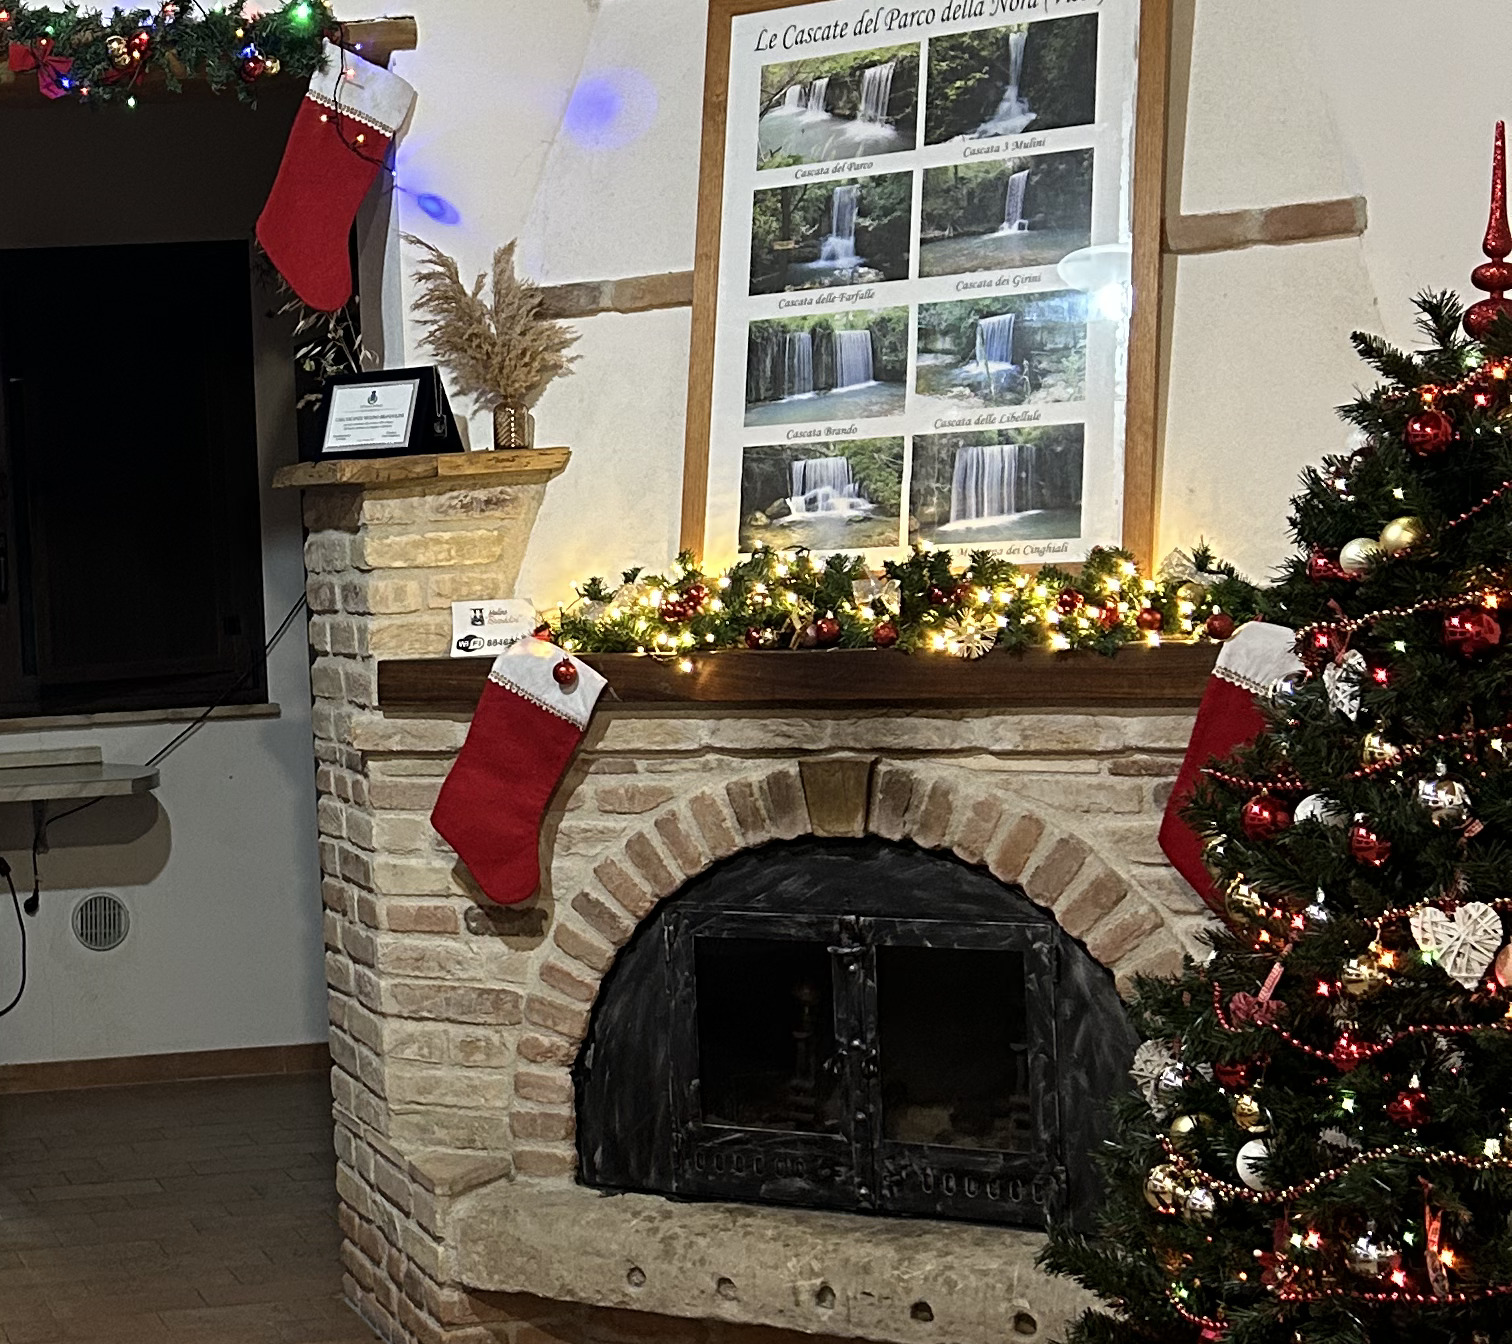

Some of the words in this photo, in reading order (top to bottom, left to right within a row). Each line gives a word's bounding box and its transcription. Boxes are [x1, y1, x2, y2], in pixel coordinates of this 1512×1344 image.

[754, 28, 777, 51] Le
[782, 19, 849, 50] Cascate
[853, 7, 884, 36] del
[885, 7, 936, 32] Parco
[963, 145, 1001, 158] Cascata
[1011, 137, 1046, 152] Mulini
[794, 167, 830, 179] Cascata
[831, 162, 847, 174] del
[847, 161, 874, 172] Parco
[955, 279, 993, 292] Cascata
[995, 274, 1010, 287] dei
[1012, 272, 1042, 288] Girini
[778, 297, 814, 310] Cascata
[815, 292, 836, 305] delle
[836, 288, 876, 304] Farfalle
[934, 417, 972, 430] Cascata
[974, 413, 997, 425] delle
[998, 409, 1042, 424] Libellule
[786, 428, 822, 440] Cascata
[823, 423, 858, 436] Brando
[1006, 544, 1020, 555] dei
[1023, 541, 1068, 557] Cinghiali
